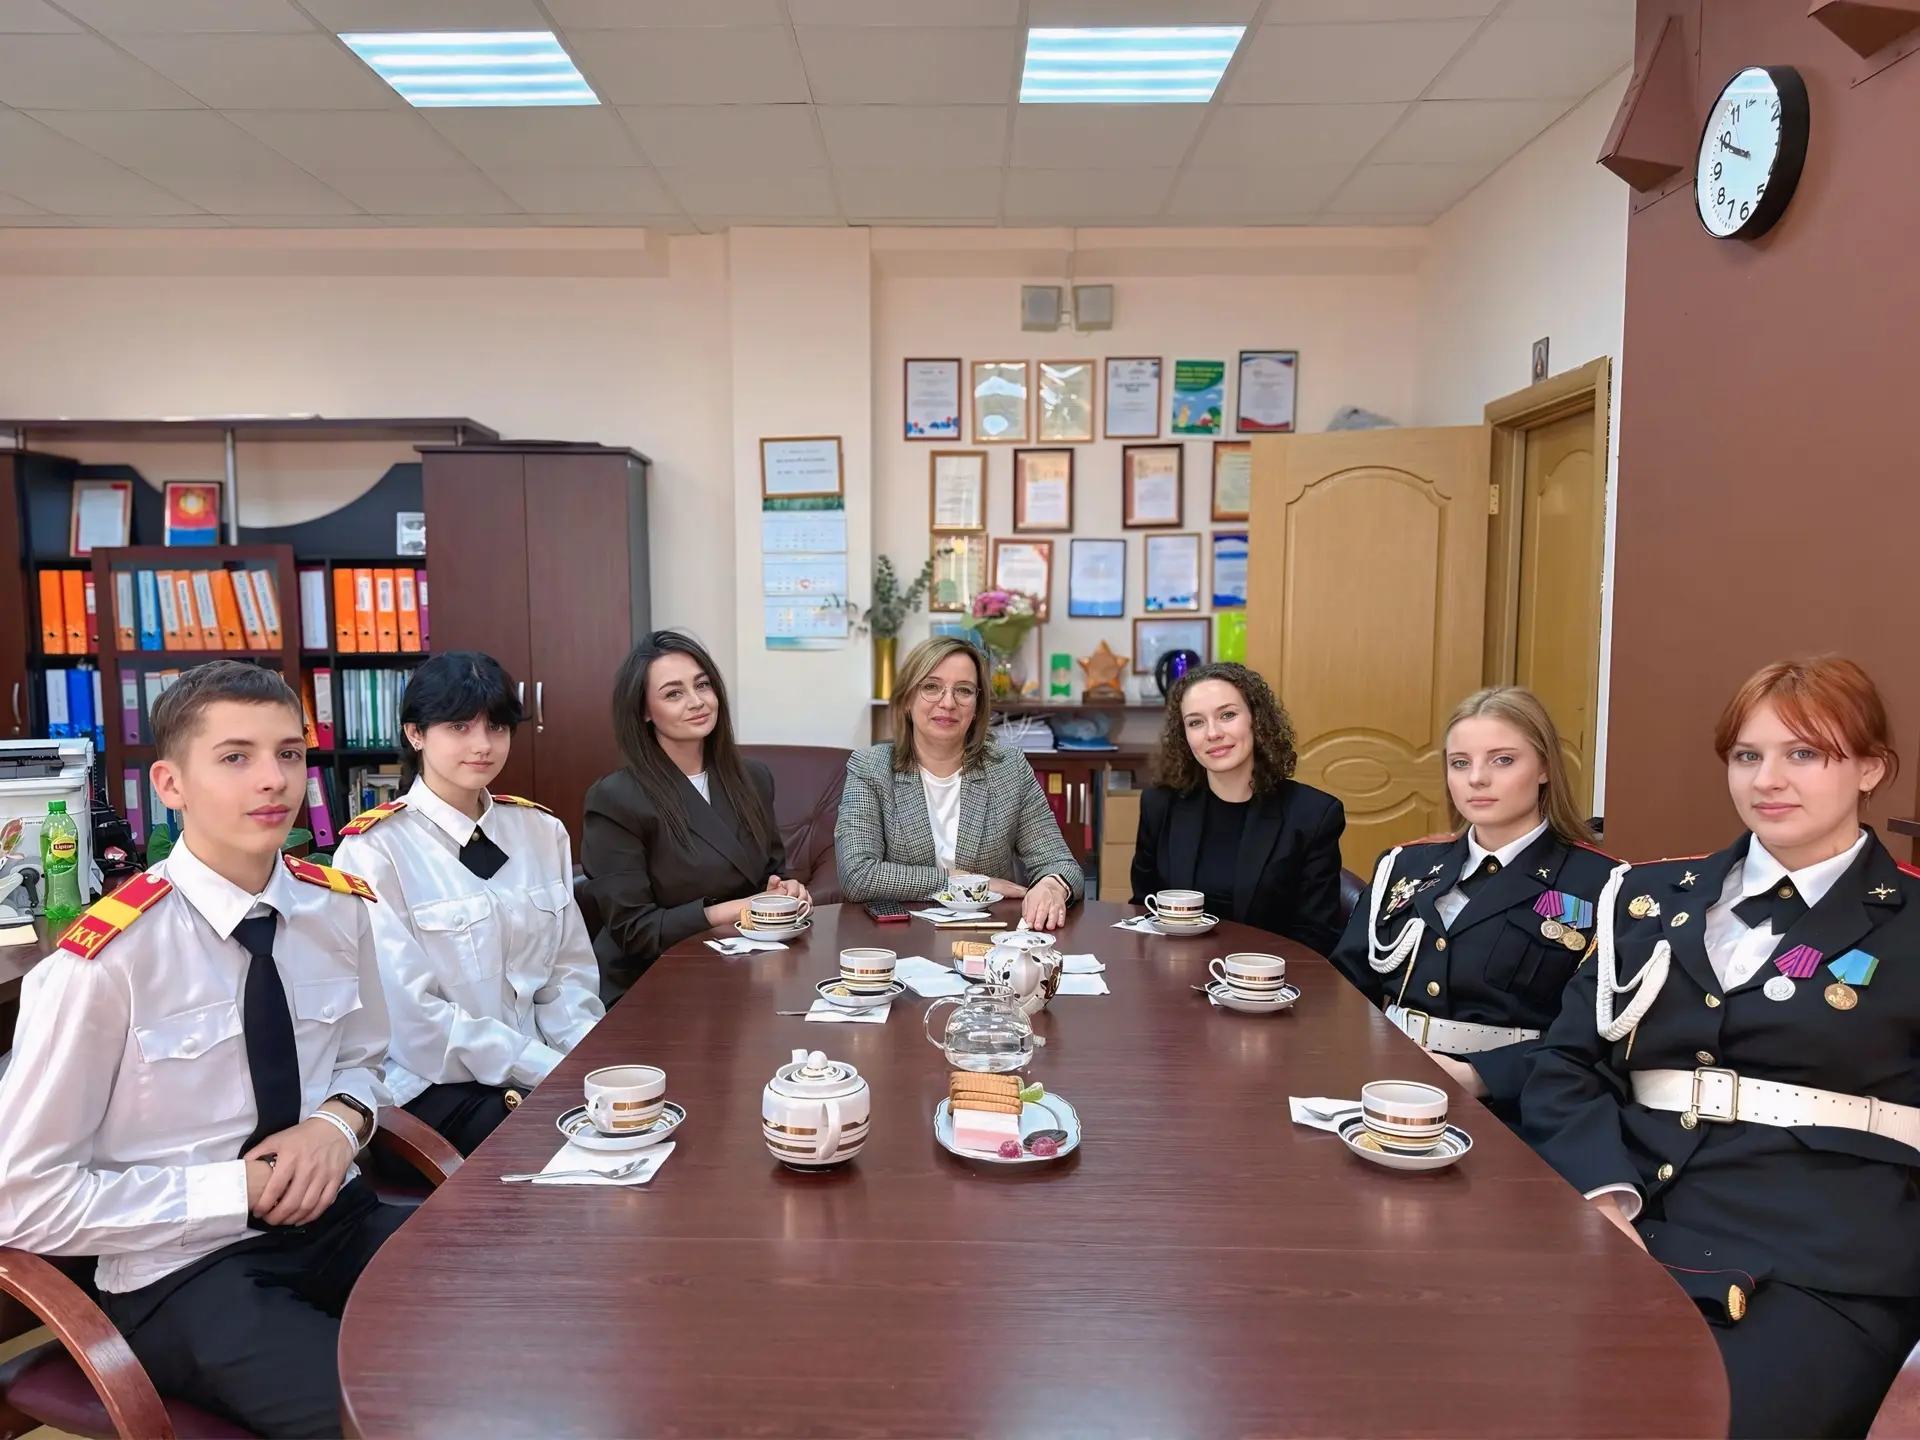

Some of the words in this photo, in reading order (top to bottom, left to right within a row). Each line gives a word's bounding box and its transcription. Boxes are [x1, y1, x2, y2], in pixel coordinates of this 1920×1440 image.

[1731, 104, 1740, 125] 11
[1771, 100, 1780, 122] 2
[1719, 131, 1732, 152] 10
[1713, 161, 1723, 181] 9
[1717, 187, 1726, 205] 8
[1727, 199, 1736, 220] 7
[1740, 201, 1750, 221] 6
[67, 926, 102, 948] КК
